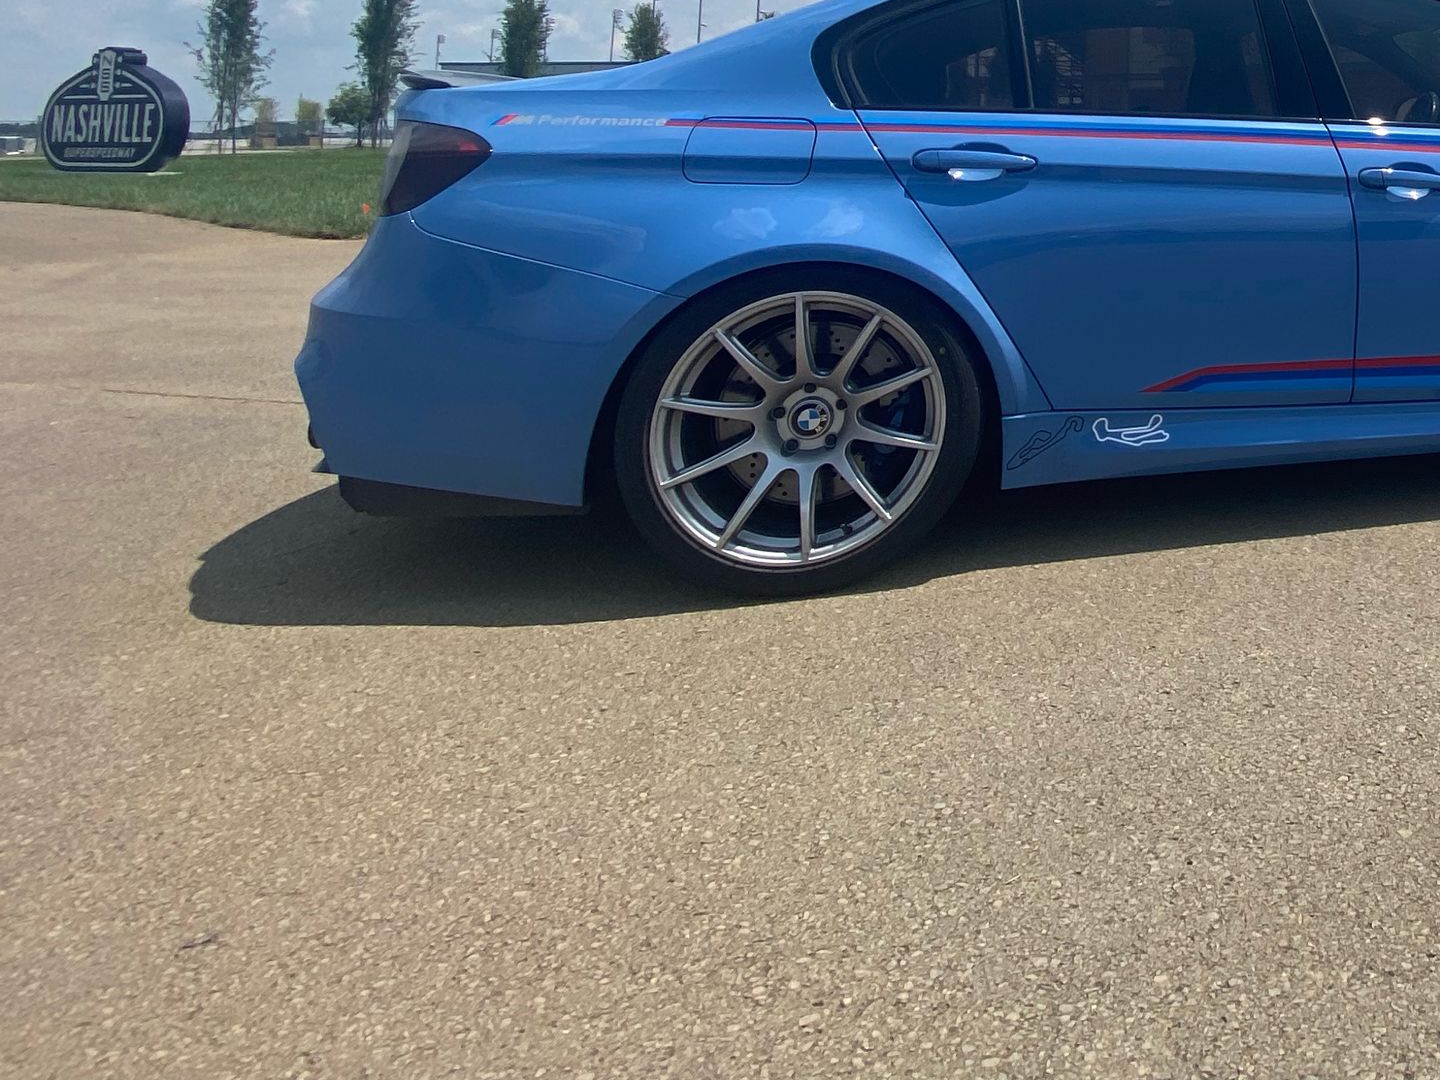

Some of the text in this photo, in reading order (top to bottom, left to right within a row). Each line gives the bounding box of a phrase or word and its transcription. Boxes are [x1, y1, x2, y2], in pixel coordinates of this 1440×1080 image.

[51, 103, 155, 143] NASHVILLE
[538, 114, 667, 127] Performance
[63, 147, 136, 159] SUPERSPEEDWAY
